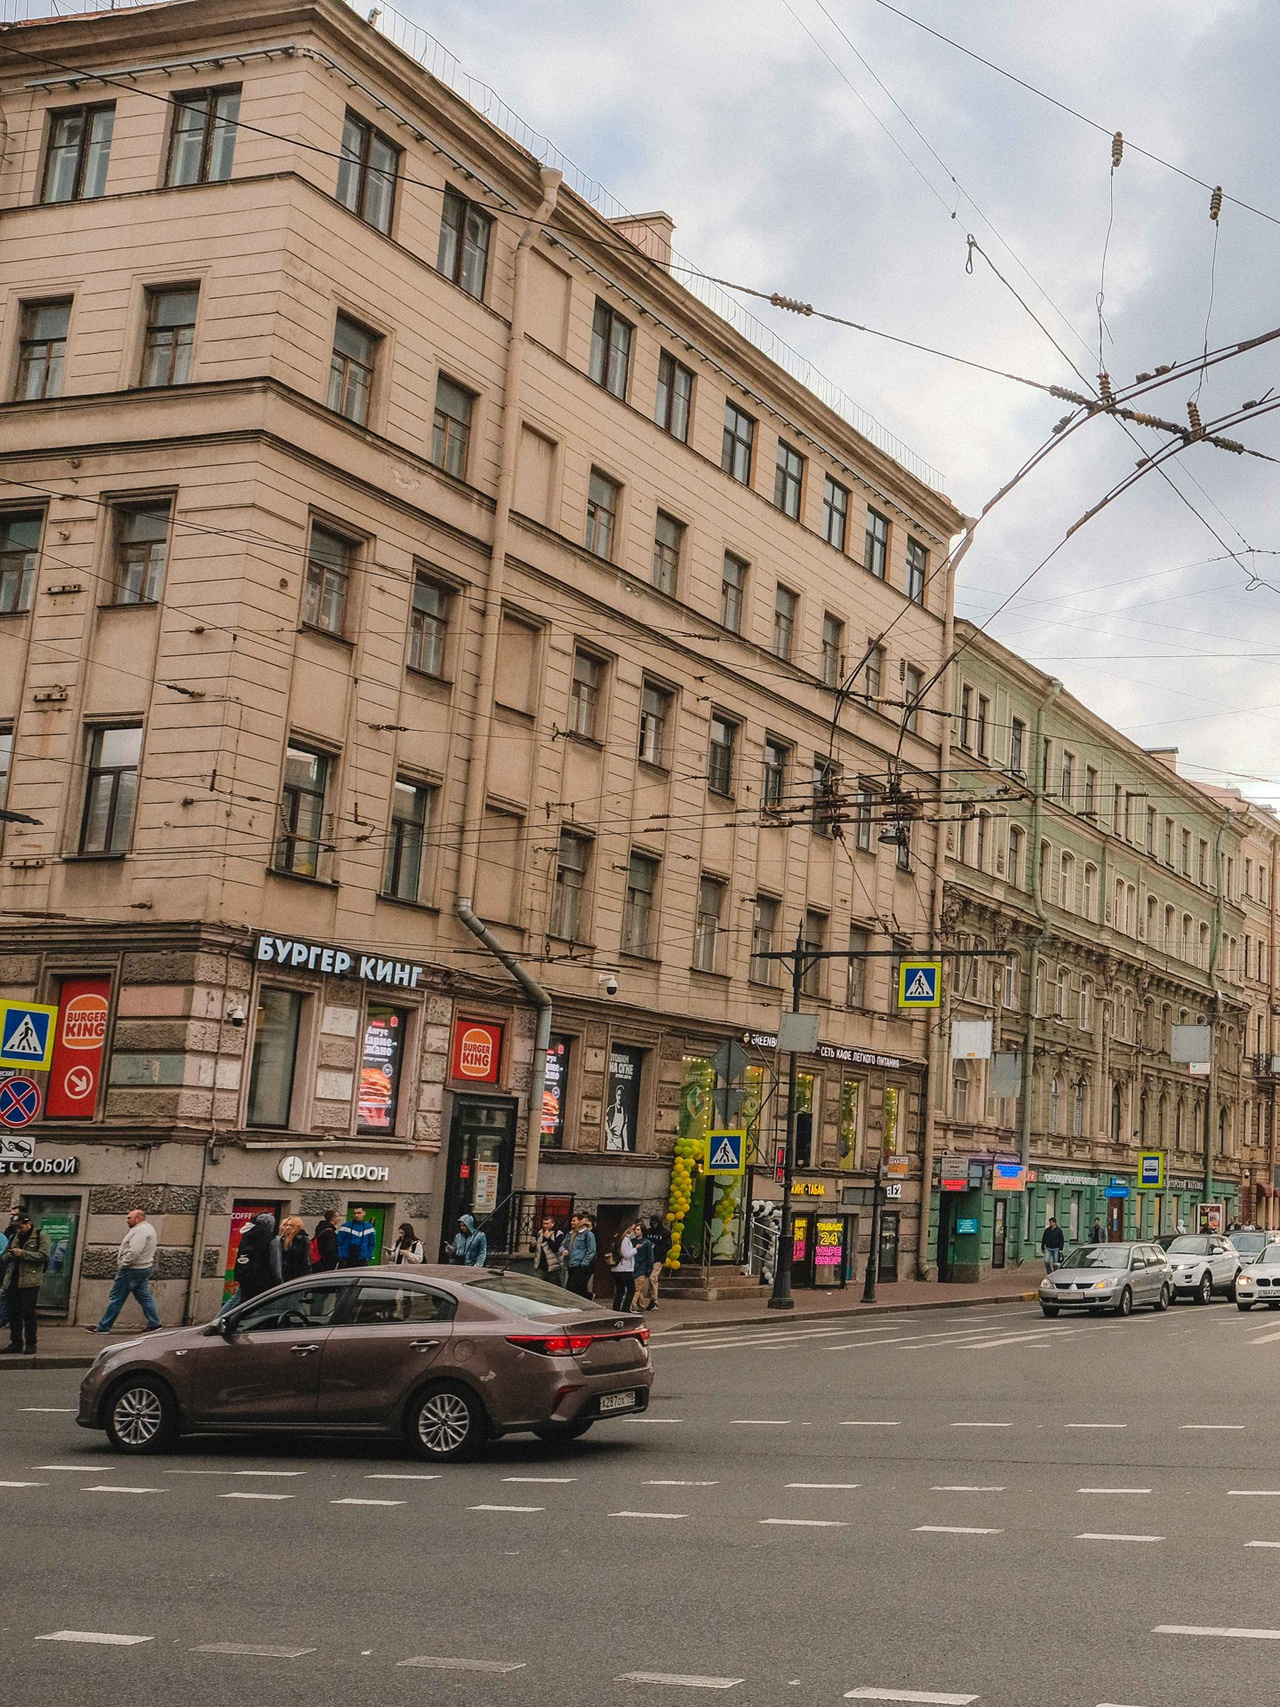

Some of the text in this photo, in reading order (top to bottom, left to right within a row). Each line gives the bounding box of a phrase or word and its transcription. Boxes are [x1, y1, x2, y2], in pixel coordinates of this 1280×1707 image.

[257, 936, 423, 988] БУРГЕР КИНГ
[67, 1011, 107, 1022] BURGER
[64, 1022, 105, 1038] KING
[463, 1042, 491, 1054] BURGER
[751, 1034, 778, 1048] GREENB
[462, 1052, 490, 1067] KING
[820, 1046, 900, 1069] СЕТЬ КАФЕ ЛЕГКОГО ПИТАНИЯ
[23, 1156, 77, 1173] СОБОЙ
[886, 1184, 902, 1198] ELE2
[820, 1231, 838, 1246] 24
[815, 1246, 842, 1256] VAPE
[815, 1255, 841, 1265] SHOP
